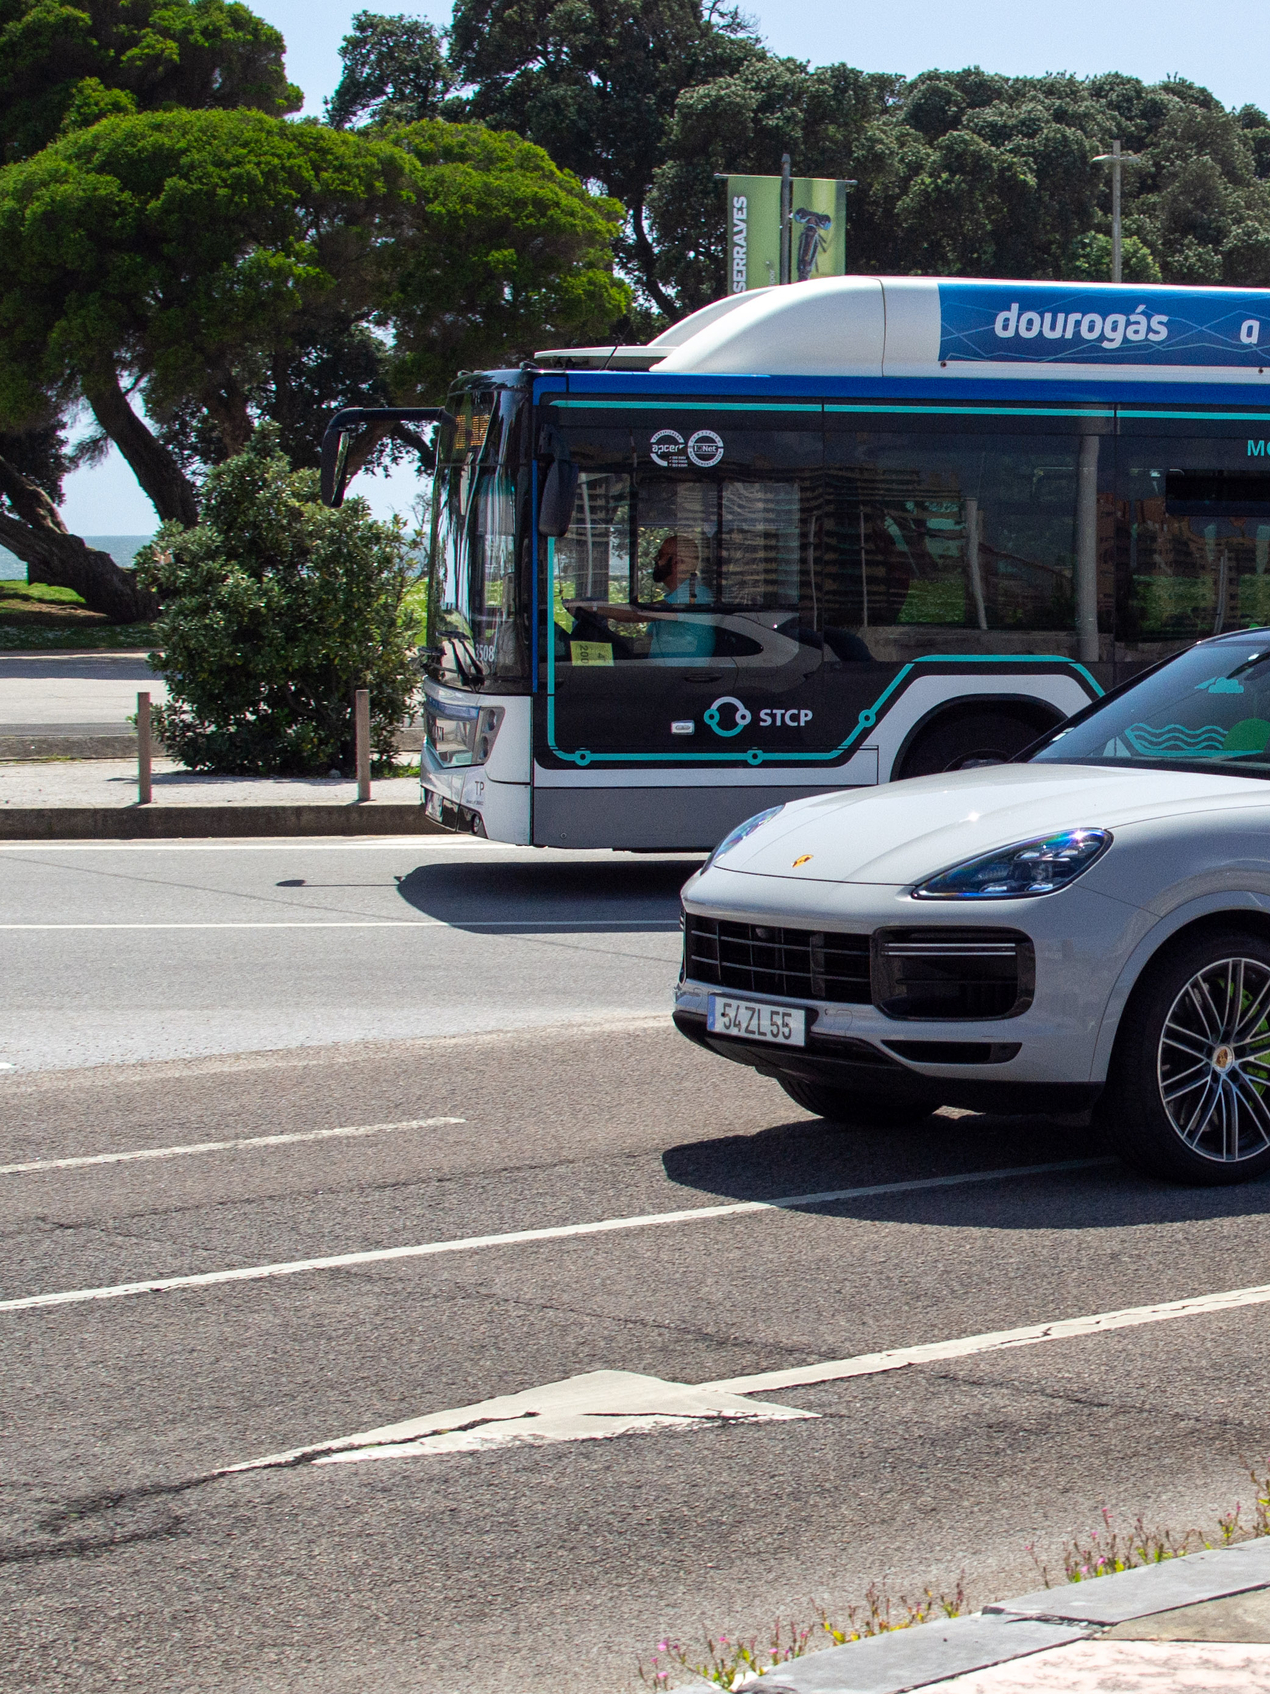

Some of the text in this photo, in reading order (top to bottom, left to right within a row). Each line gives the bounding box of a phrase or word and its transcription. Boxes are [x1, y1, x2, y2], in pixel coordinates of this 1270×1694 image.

[994, 303, 1169, 349] dourogás
[1240, 319, 1260, 344] a
[652, 444, 682, 455] apcer
[475, 643, 495, 662] 3508
[759, 709, 813, 726] STCP
[475, 780, 485, 796] TP
